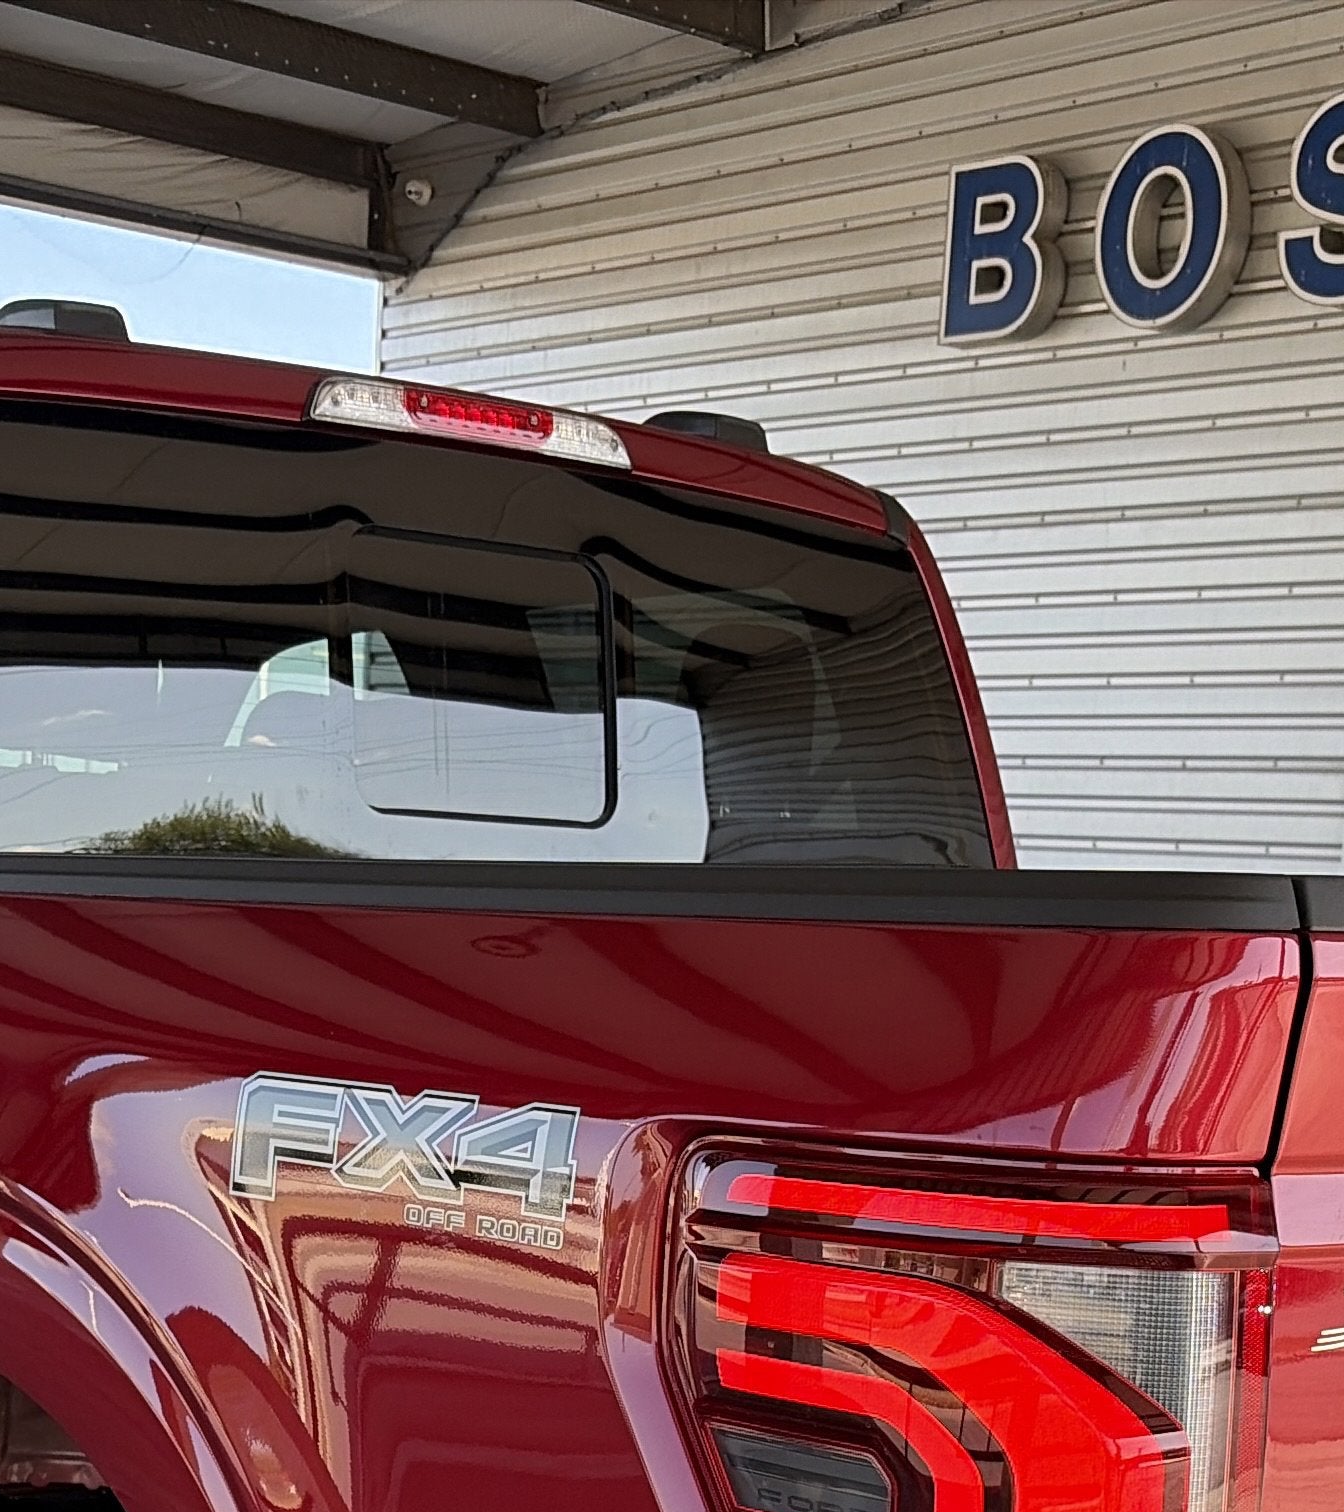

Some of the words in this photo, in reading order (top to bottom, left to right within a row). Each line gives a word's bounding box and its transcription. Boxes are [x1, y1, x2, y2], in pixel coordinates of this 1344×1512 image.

[229, 1070, 580, 1222] FX4
[404, 1203, 466, 1232] OFF
[475, 1215, 565, 1250] ROAD
